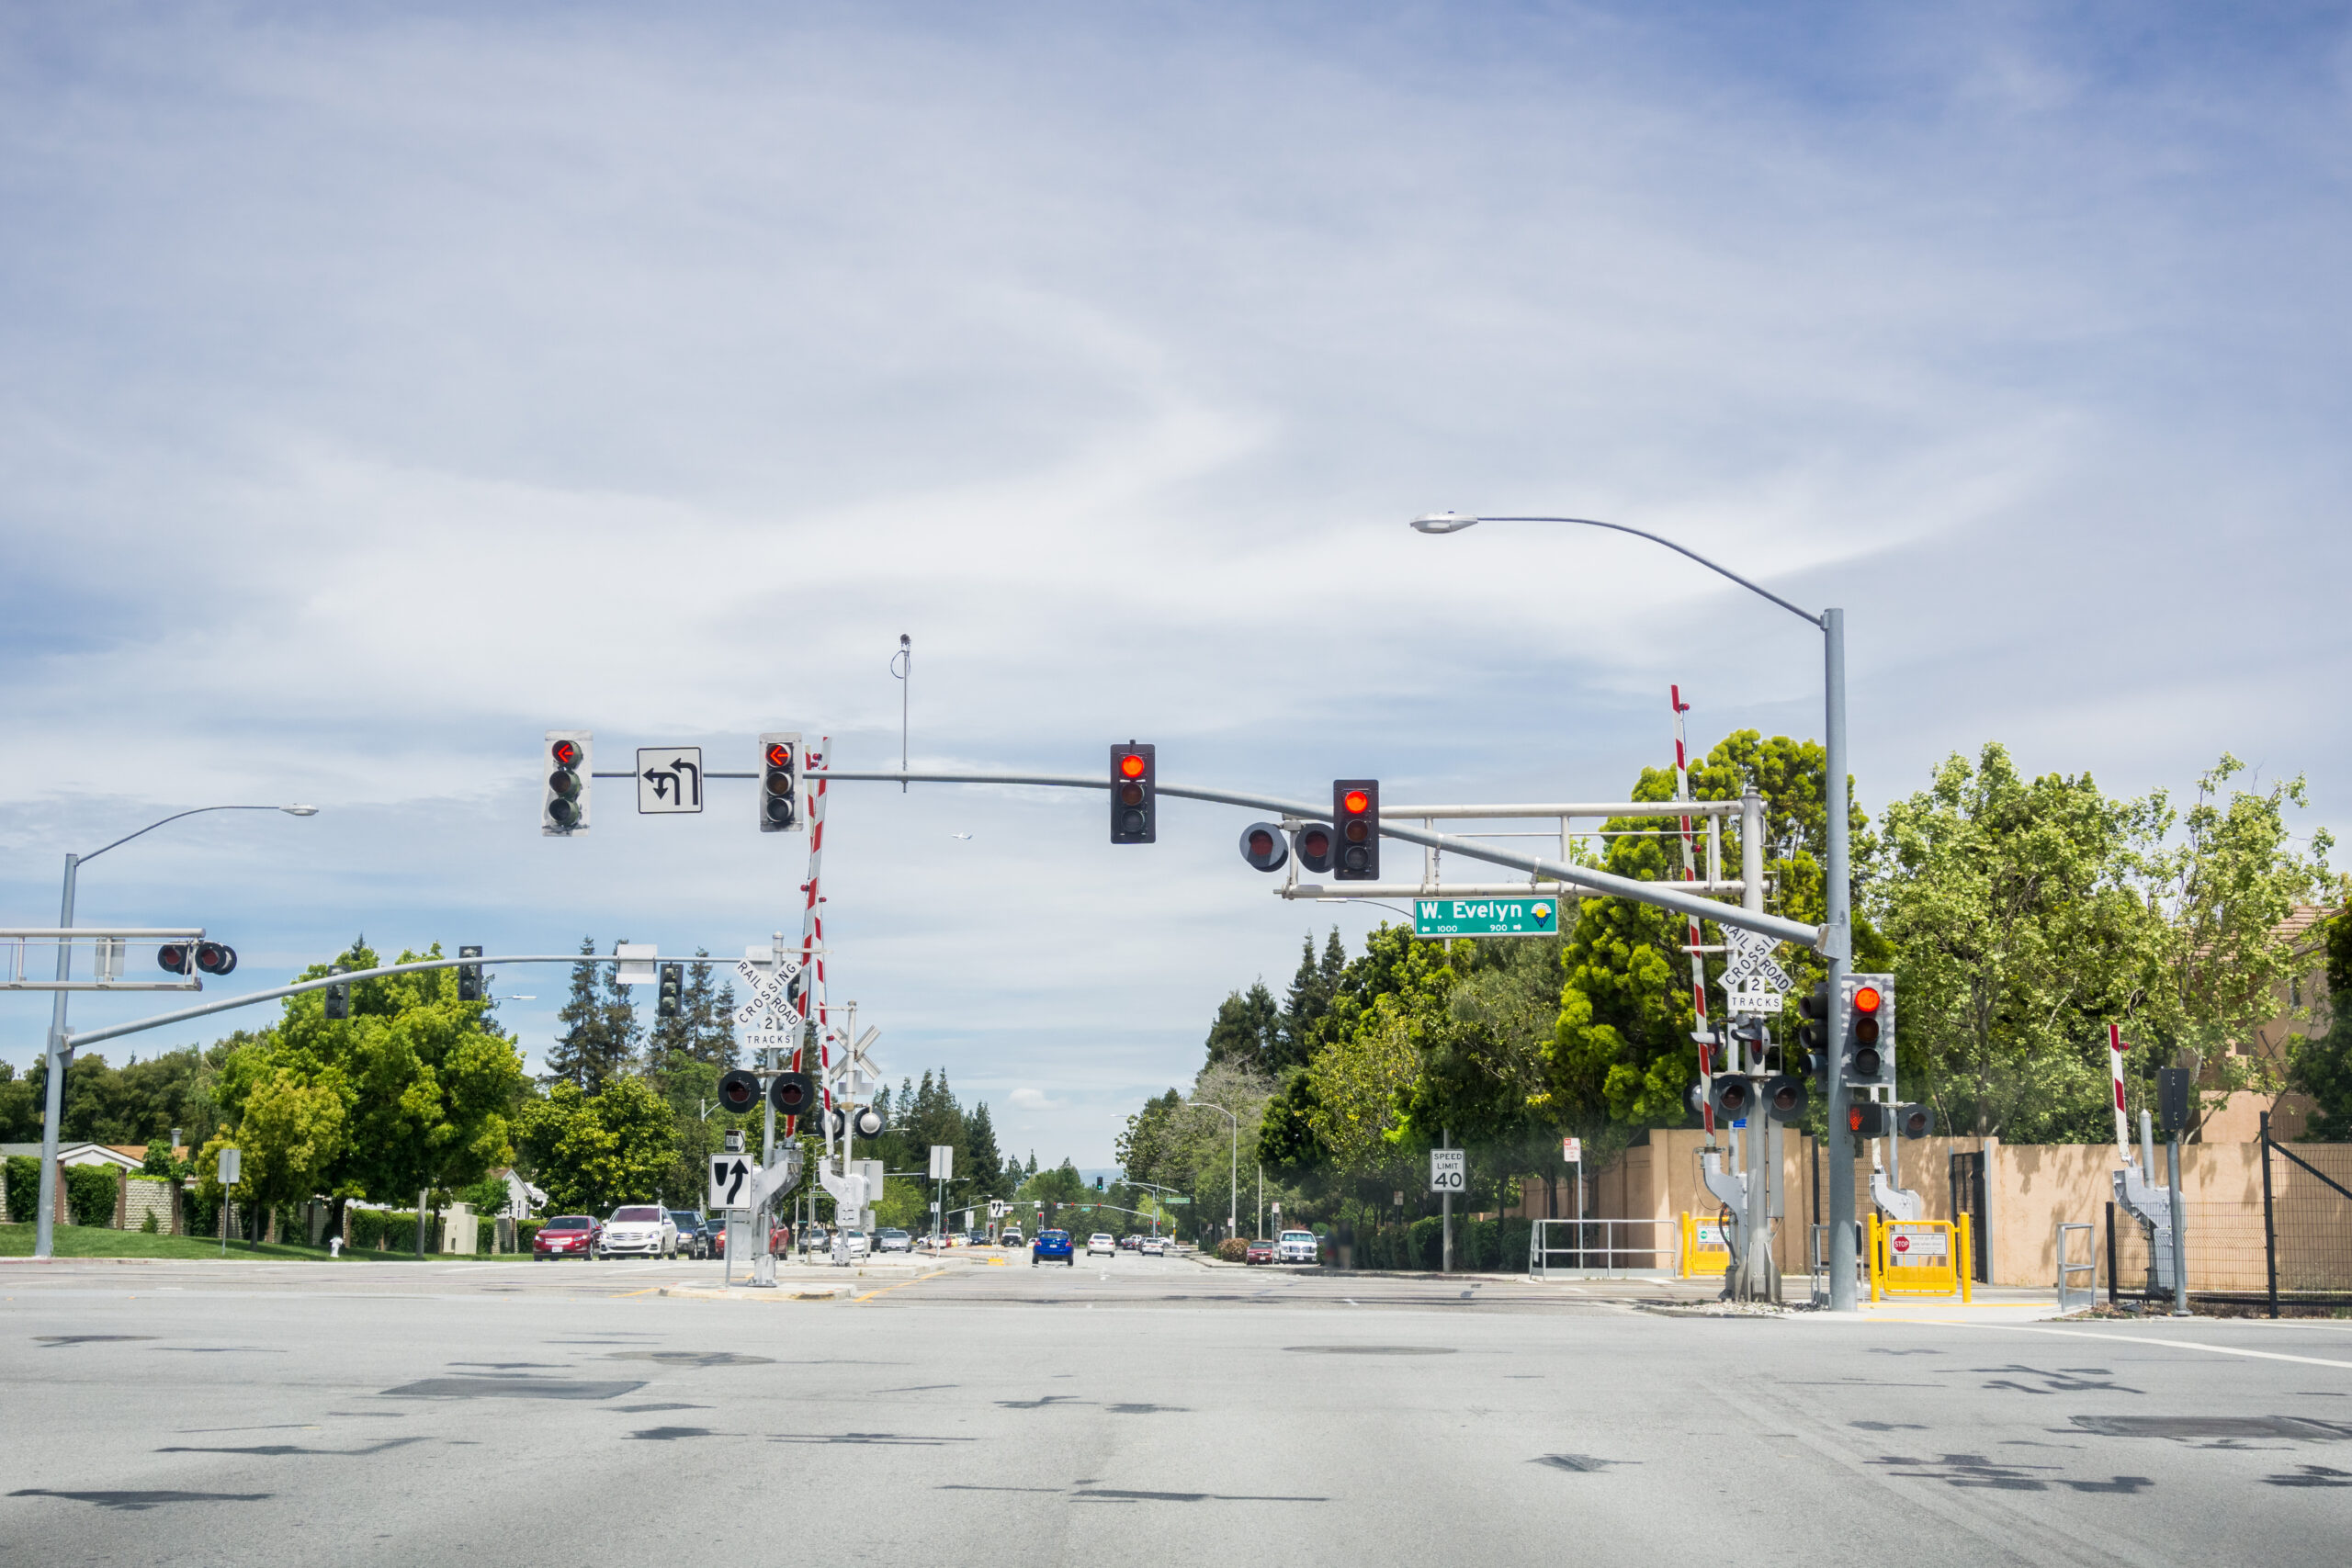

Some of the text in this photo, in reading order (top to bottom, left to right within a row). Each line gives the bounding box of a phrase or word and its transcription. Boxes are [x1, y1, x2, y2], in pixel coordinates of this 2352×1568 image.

[1420, 901, 1522, 921] W. Evelyn
[1725, 936, 1776, 985] CROSSI
[737, 962, 762, 989] RAIL
[1759, 959, 1789, 989] ROAD
[739, 964, 796, 1023] CROSSING
[1751, 978, 1760, 991] 2
[772, 997, 798, 1025] ROAD
[1732, 997, 1780, 1007] TRACKS
[764, 1017, 773, 1030] 2
[747, 1035, 790, 1043] TRACKS
[1433, 1172, 1463, 1188] 40
